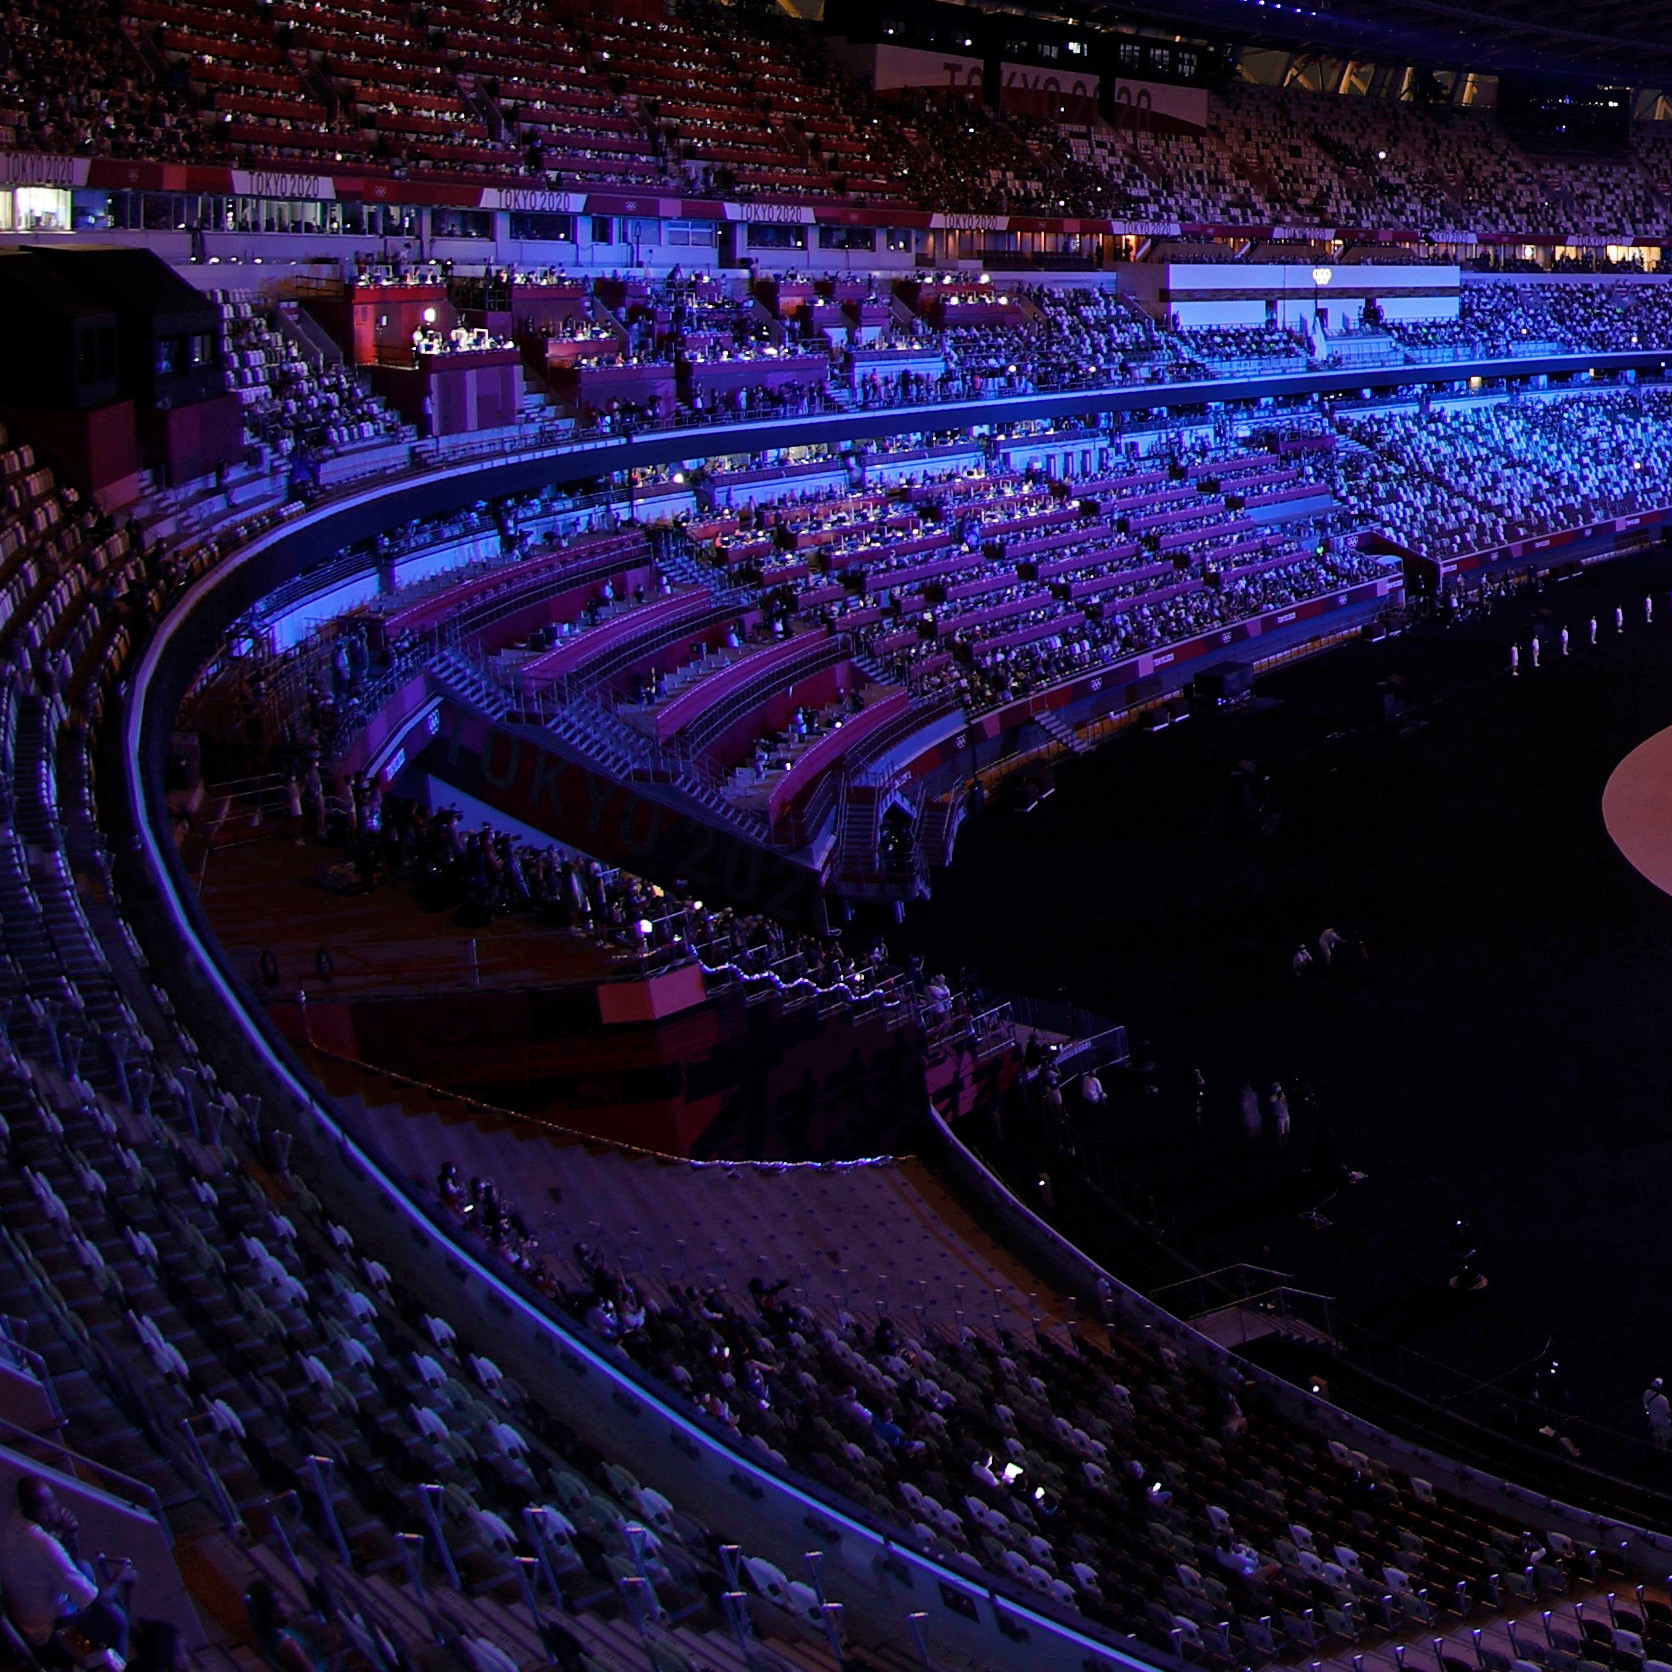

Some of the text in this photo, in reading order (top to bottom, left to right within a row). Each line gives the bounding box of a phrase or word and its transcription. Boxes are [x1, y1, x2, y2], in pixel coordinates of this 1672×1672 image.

[250, 172, 320, 197] TOKYO 2020
[499, 190, 570, 211] TOKYO 2020
[740, 205, 802, 222] TOKYO 2020
[945, 215, 997, 229] TOKYO 2020
